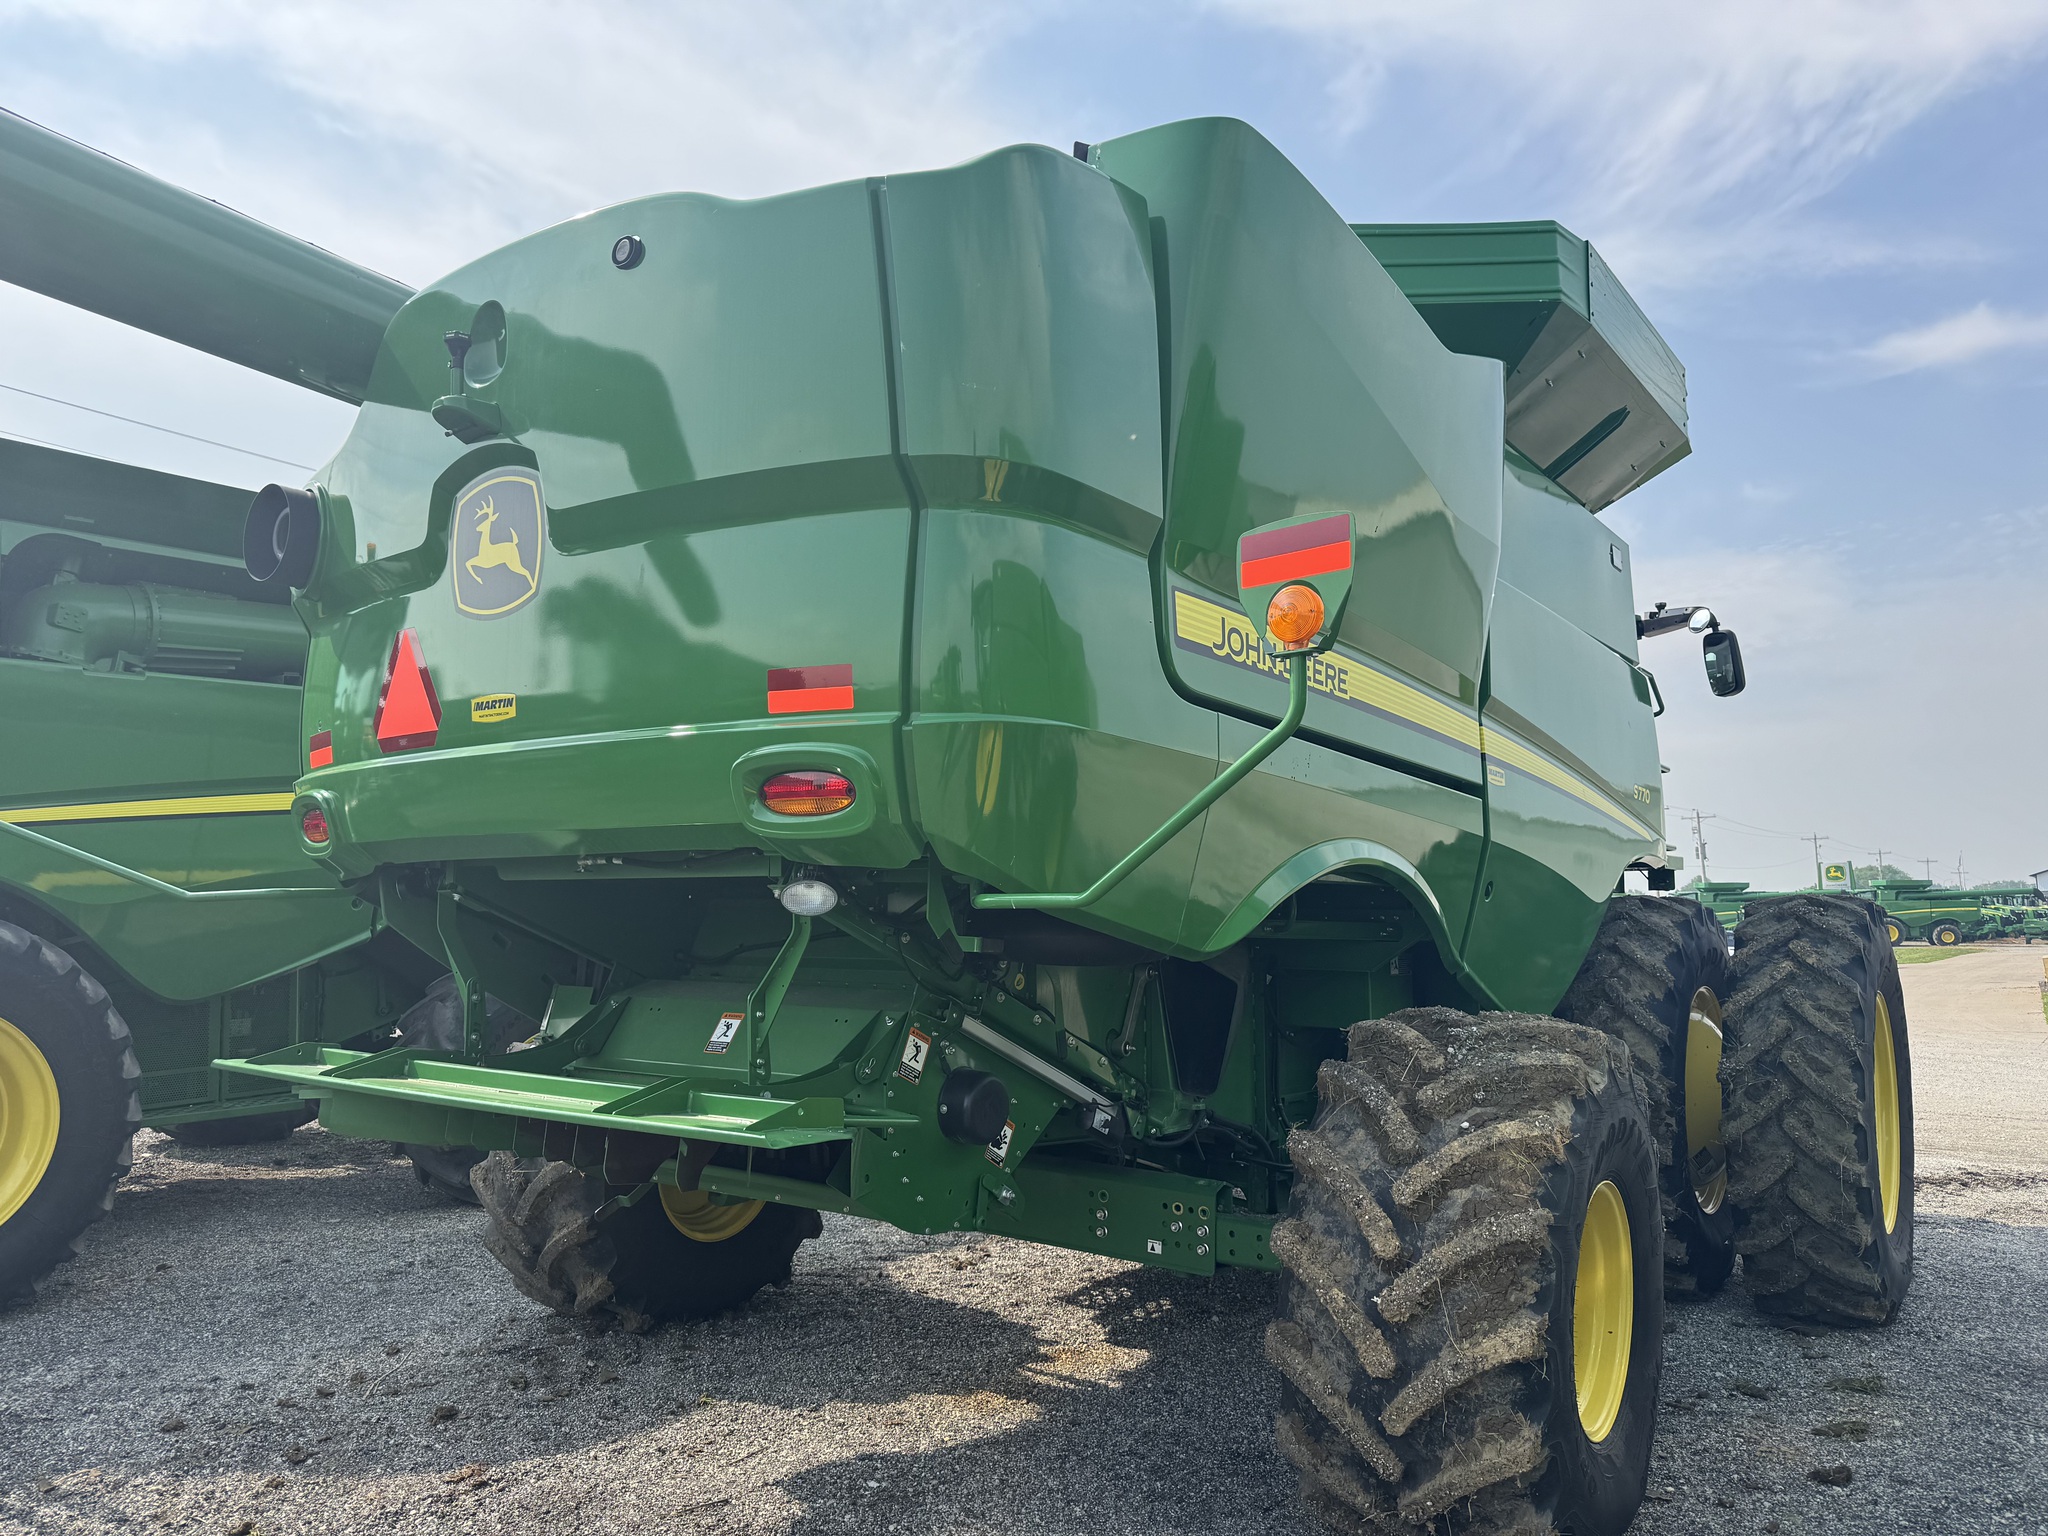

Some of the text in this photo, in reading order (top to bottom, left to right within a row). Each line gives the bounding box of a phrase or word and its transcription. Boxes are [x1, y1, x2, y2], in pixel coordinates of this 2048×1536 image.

[1212, 616, 1278, 671] JOHN
[473, 697, 514, 712] MARTIN
[1633, 784, 1651, 805] S770
